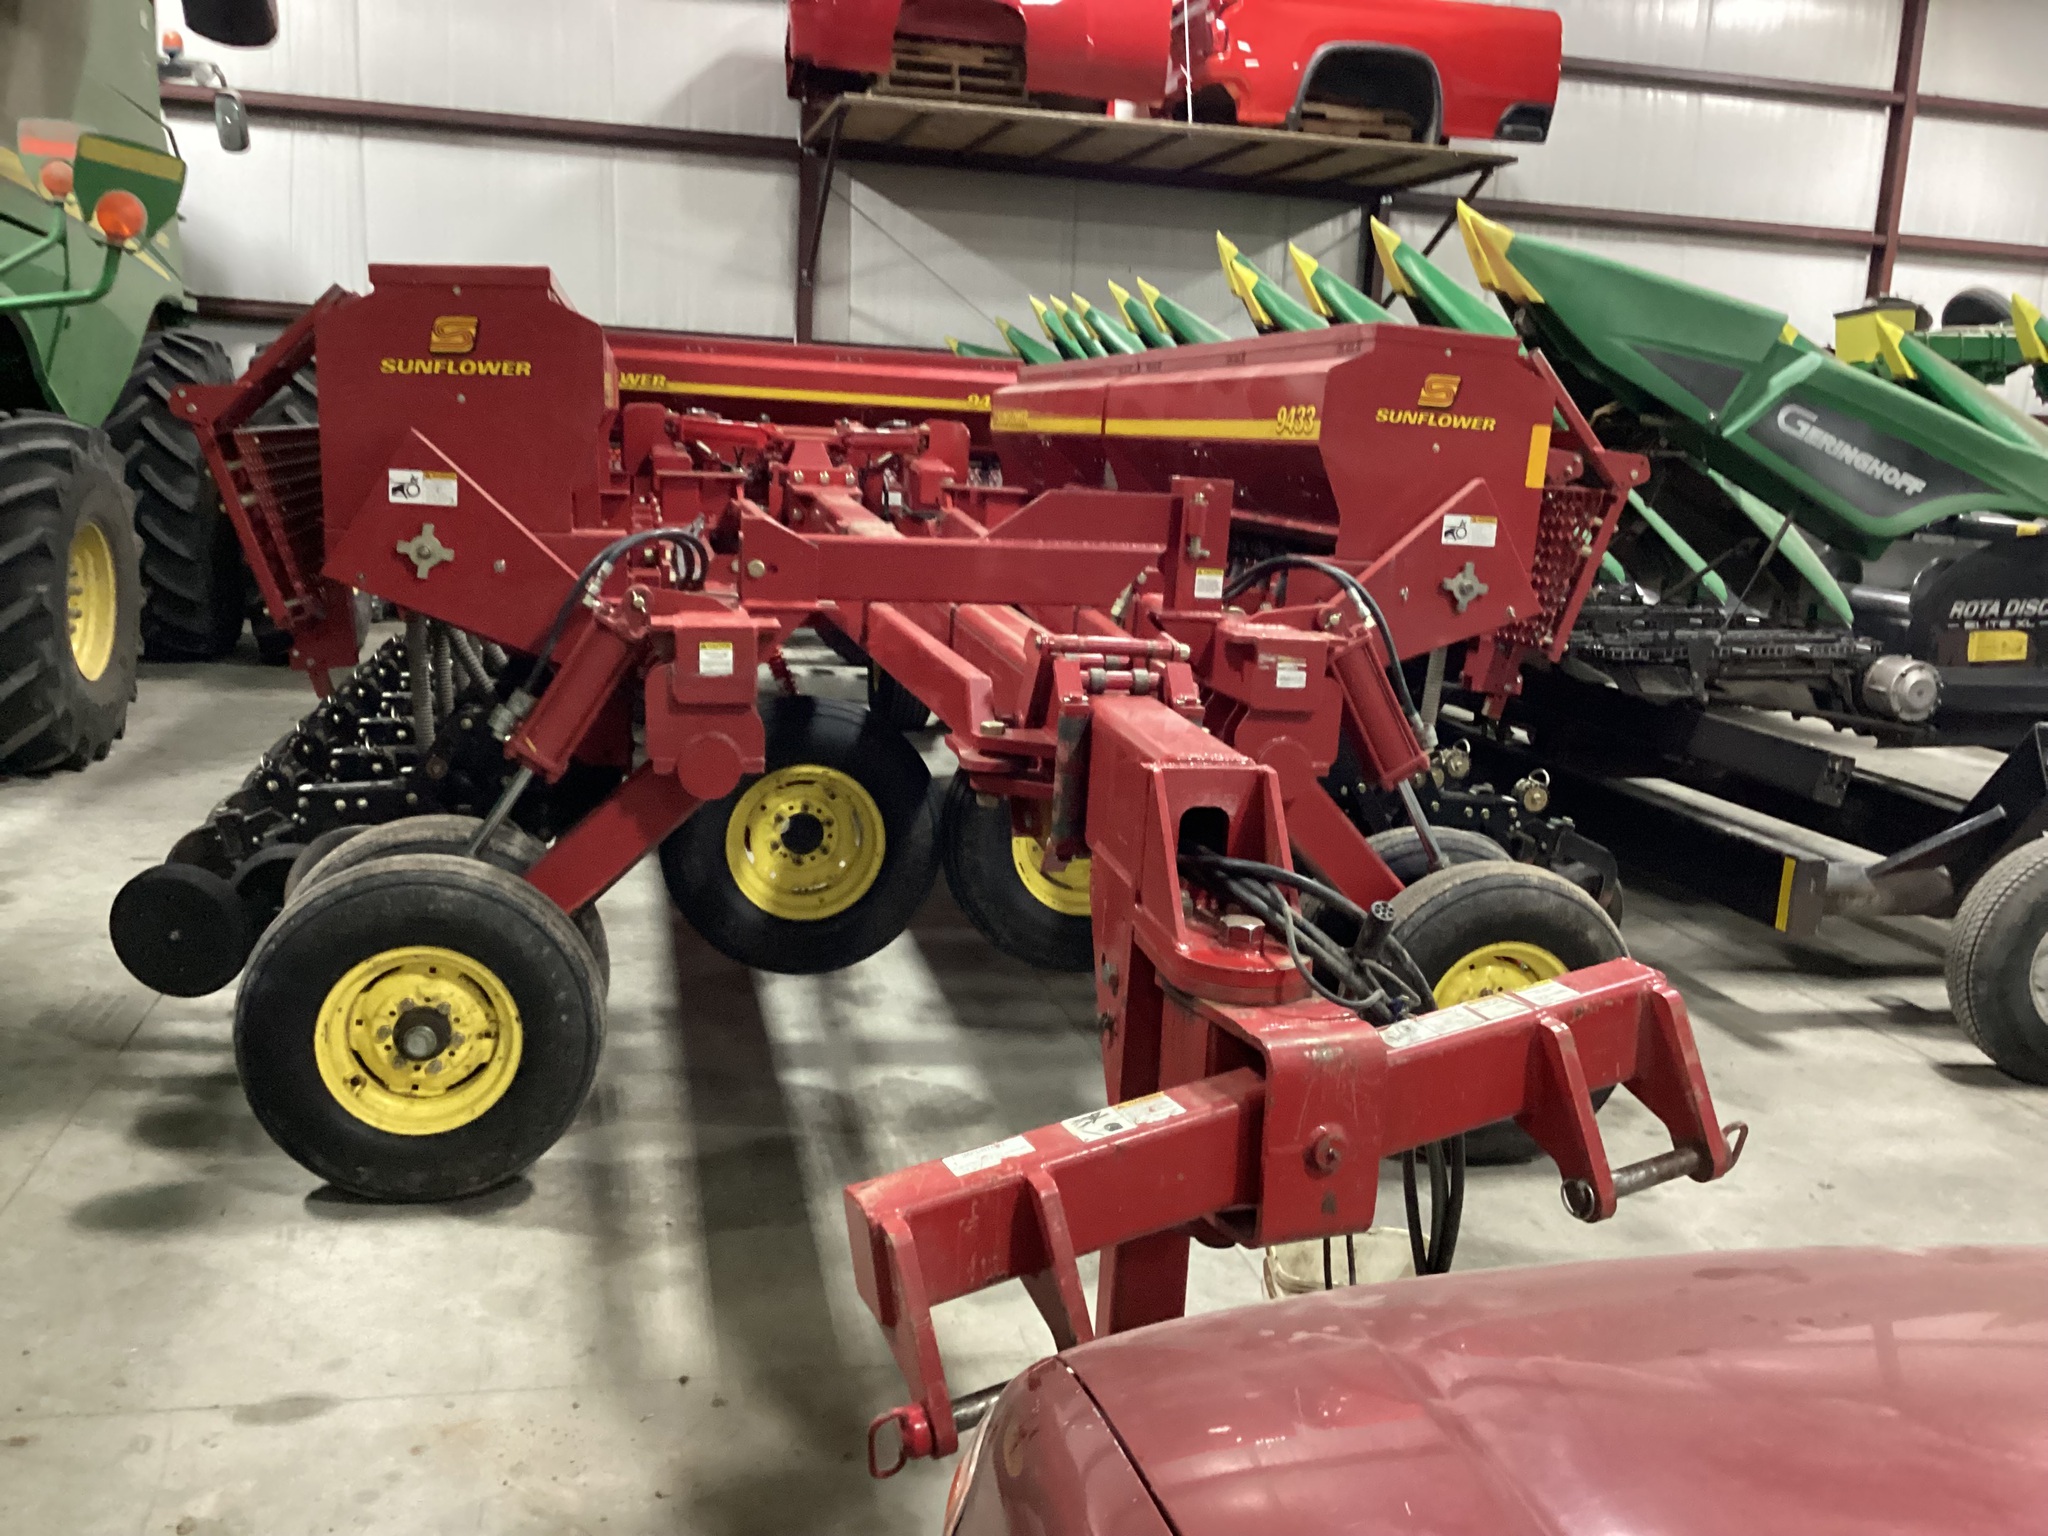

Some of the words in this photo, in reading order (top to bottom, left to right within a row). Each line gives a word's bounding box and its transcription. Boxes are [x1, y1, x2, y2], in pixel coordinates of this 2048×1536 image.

[379, 357, 532, 377] SUNFLOWER
[1276, 404, 1317, 434] 9433
[1375, 407, 1497, 432] SUNFLOWER
[1777, 403, 1927, 496] GERINGHOFF
[1948, 599, 2001, 620] ROTA
[2003, 598, 2048, 617] DISC
